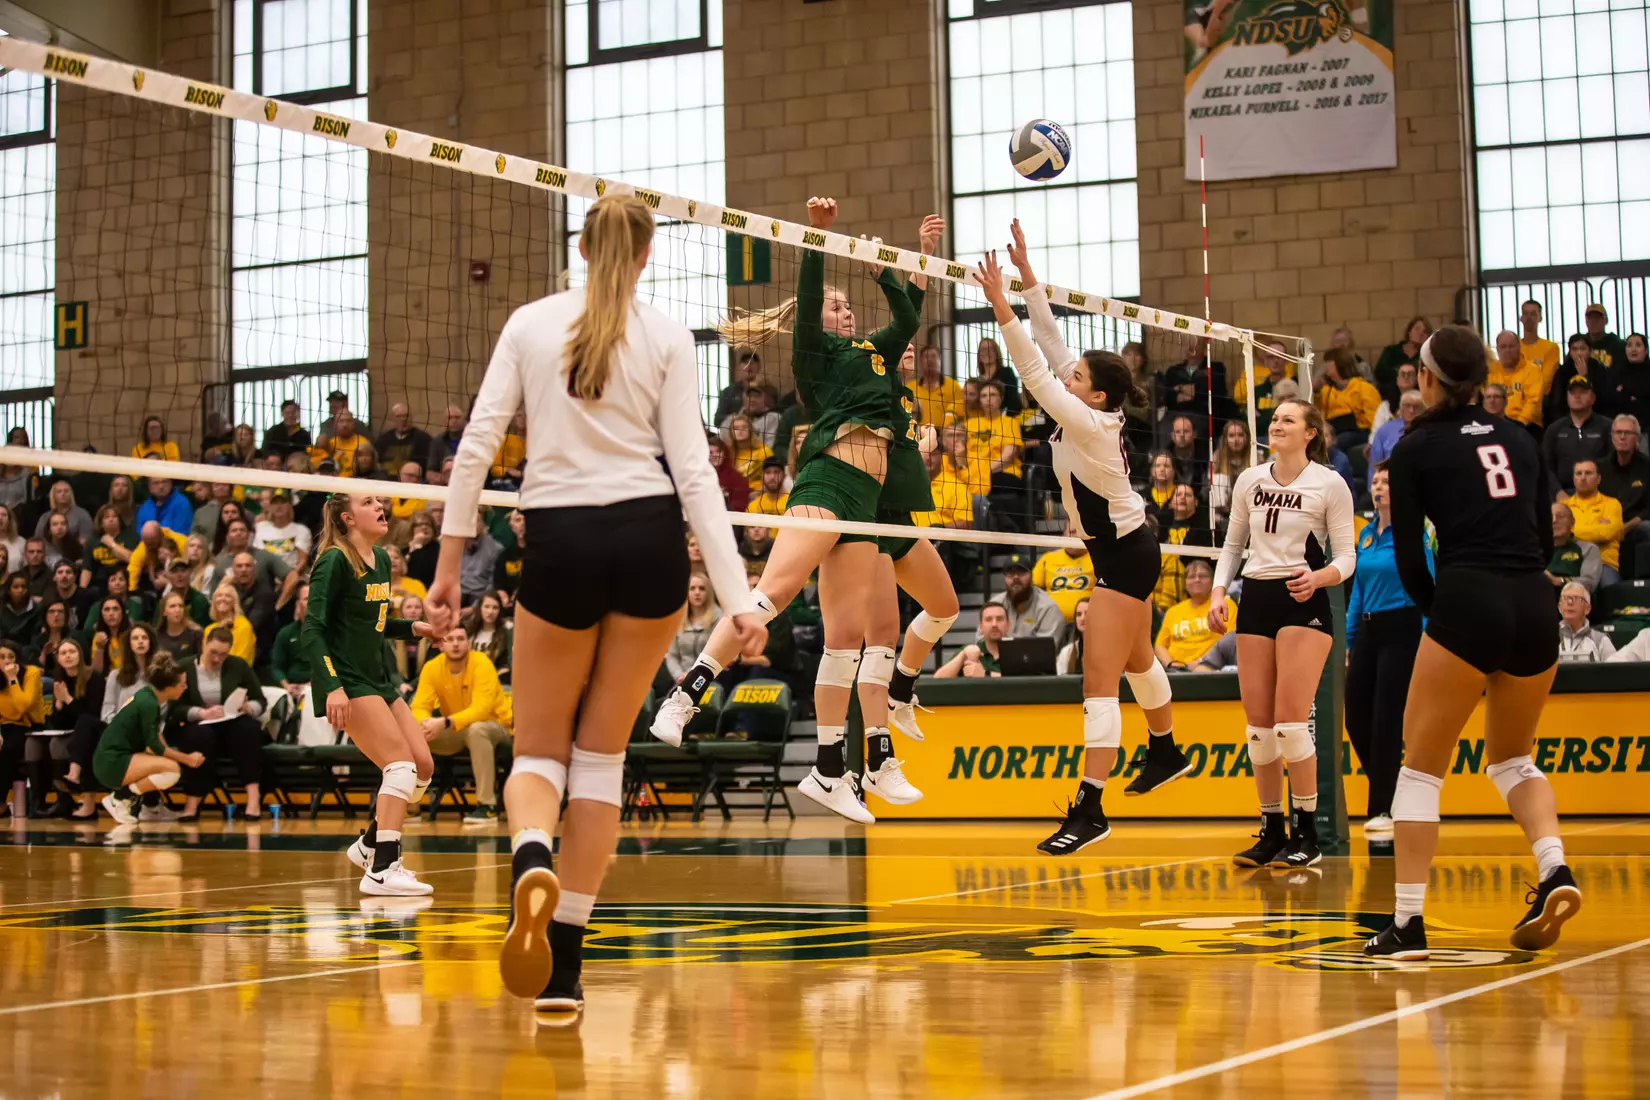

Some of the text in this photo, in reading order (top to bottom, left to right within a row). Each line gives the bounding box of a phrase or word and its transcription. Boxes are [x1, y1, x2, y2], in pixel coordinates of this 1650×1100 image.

[1232, 17, 1316, 46] NDSU
[44, 54, 88, 78] BISON
[1224, 65, 1256, 80] KARI
[1259, 62, 1308, 78] FAGNAN
[1320, 58, 1350, 72] 2007
[184, 86, 225, 109] BISON
[1203, 83, 1241, 99] KELLY
[1244, 81, 1283, 96] LOPEZ
[1296, 77, 1325, 92] 2008
[1330, 76, 1338, 89] &
[1344, 74, 1374, 87] 2009
[1189, 103, 1241, 120] MIKAELA
[1245, 99, 1300, 115] PURNELL
[1314, 95, 1340, 109] 2016
[1344, 94, 1352, 107] &
[1358, 92, 1388, 106] 2017
[312, 115, 350, 138] BISON
[430, 142, 463, 163] BISON
[535, 168, 567, 188] BISON
[721, 211, 747, 229] BISON
[802, 231, 826, 247] BISON
[877, 248, 898, 264] BISON
[945, 264, 966, 280] BISON
[1068, 293, 1087, 307] BISON
[58, 304, 84, 347] H
[1477, 444, 1517, 498] 8
[1253, 491, 1302, 510] OMAHA
[1264, 508, 1280, 534] 11
[375, 603, 388, 632] 5
[732, 688, 783, 704] BISON
[948, 745, 1083, 780] NORTH
[1108, 743, 1255, 778] DAOTA
